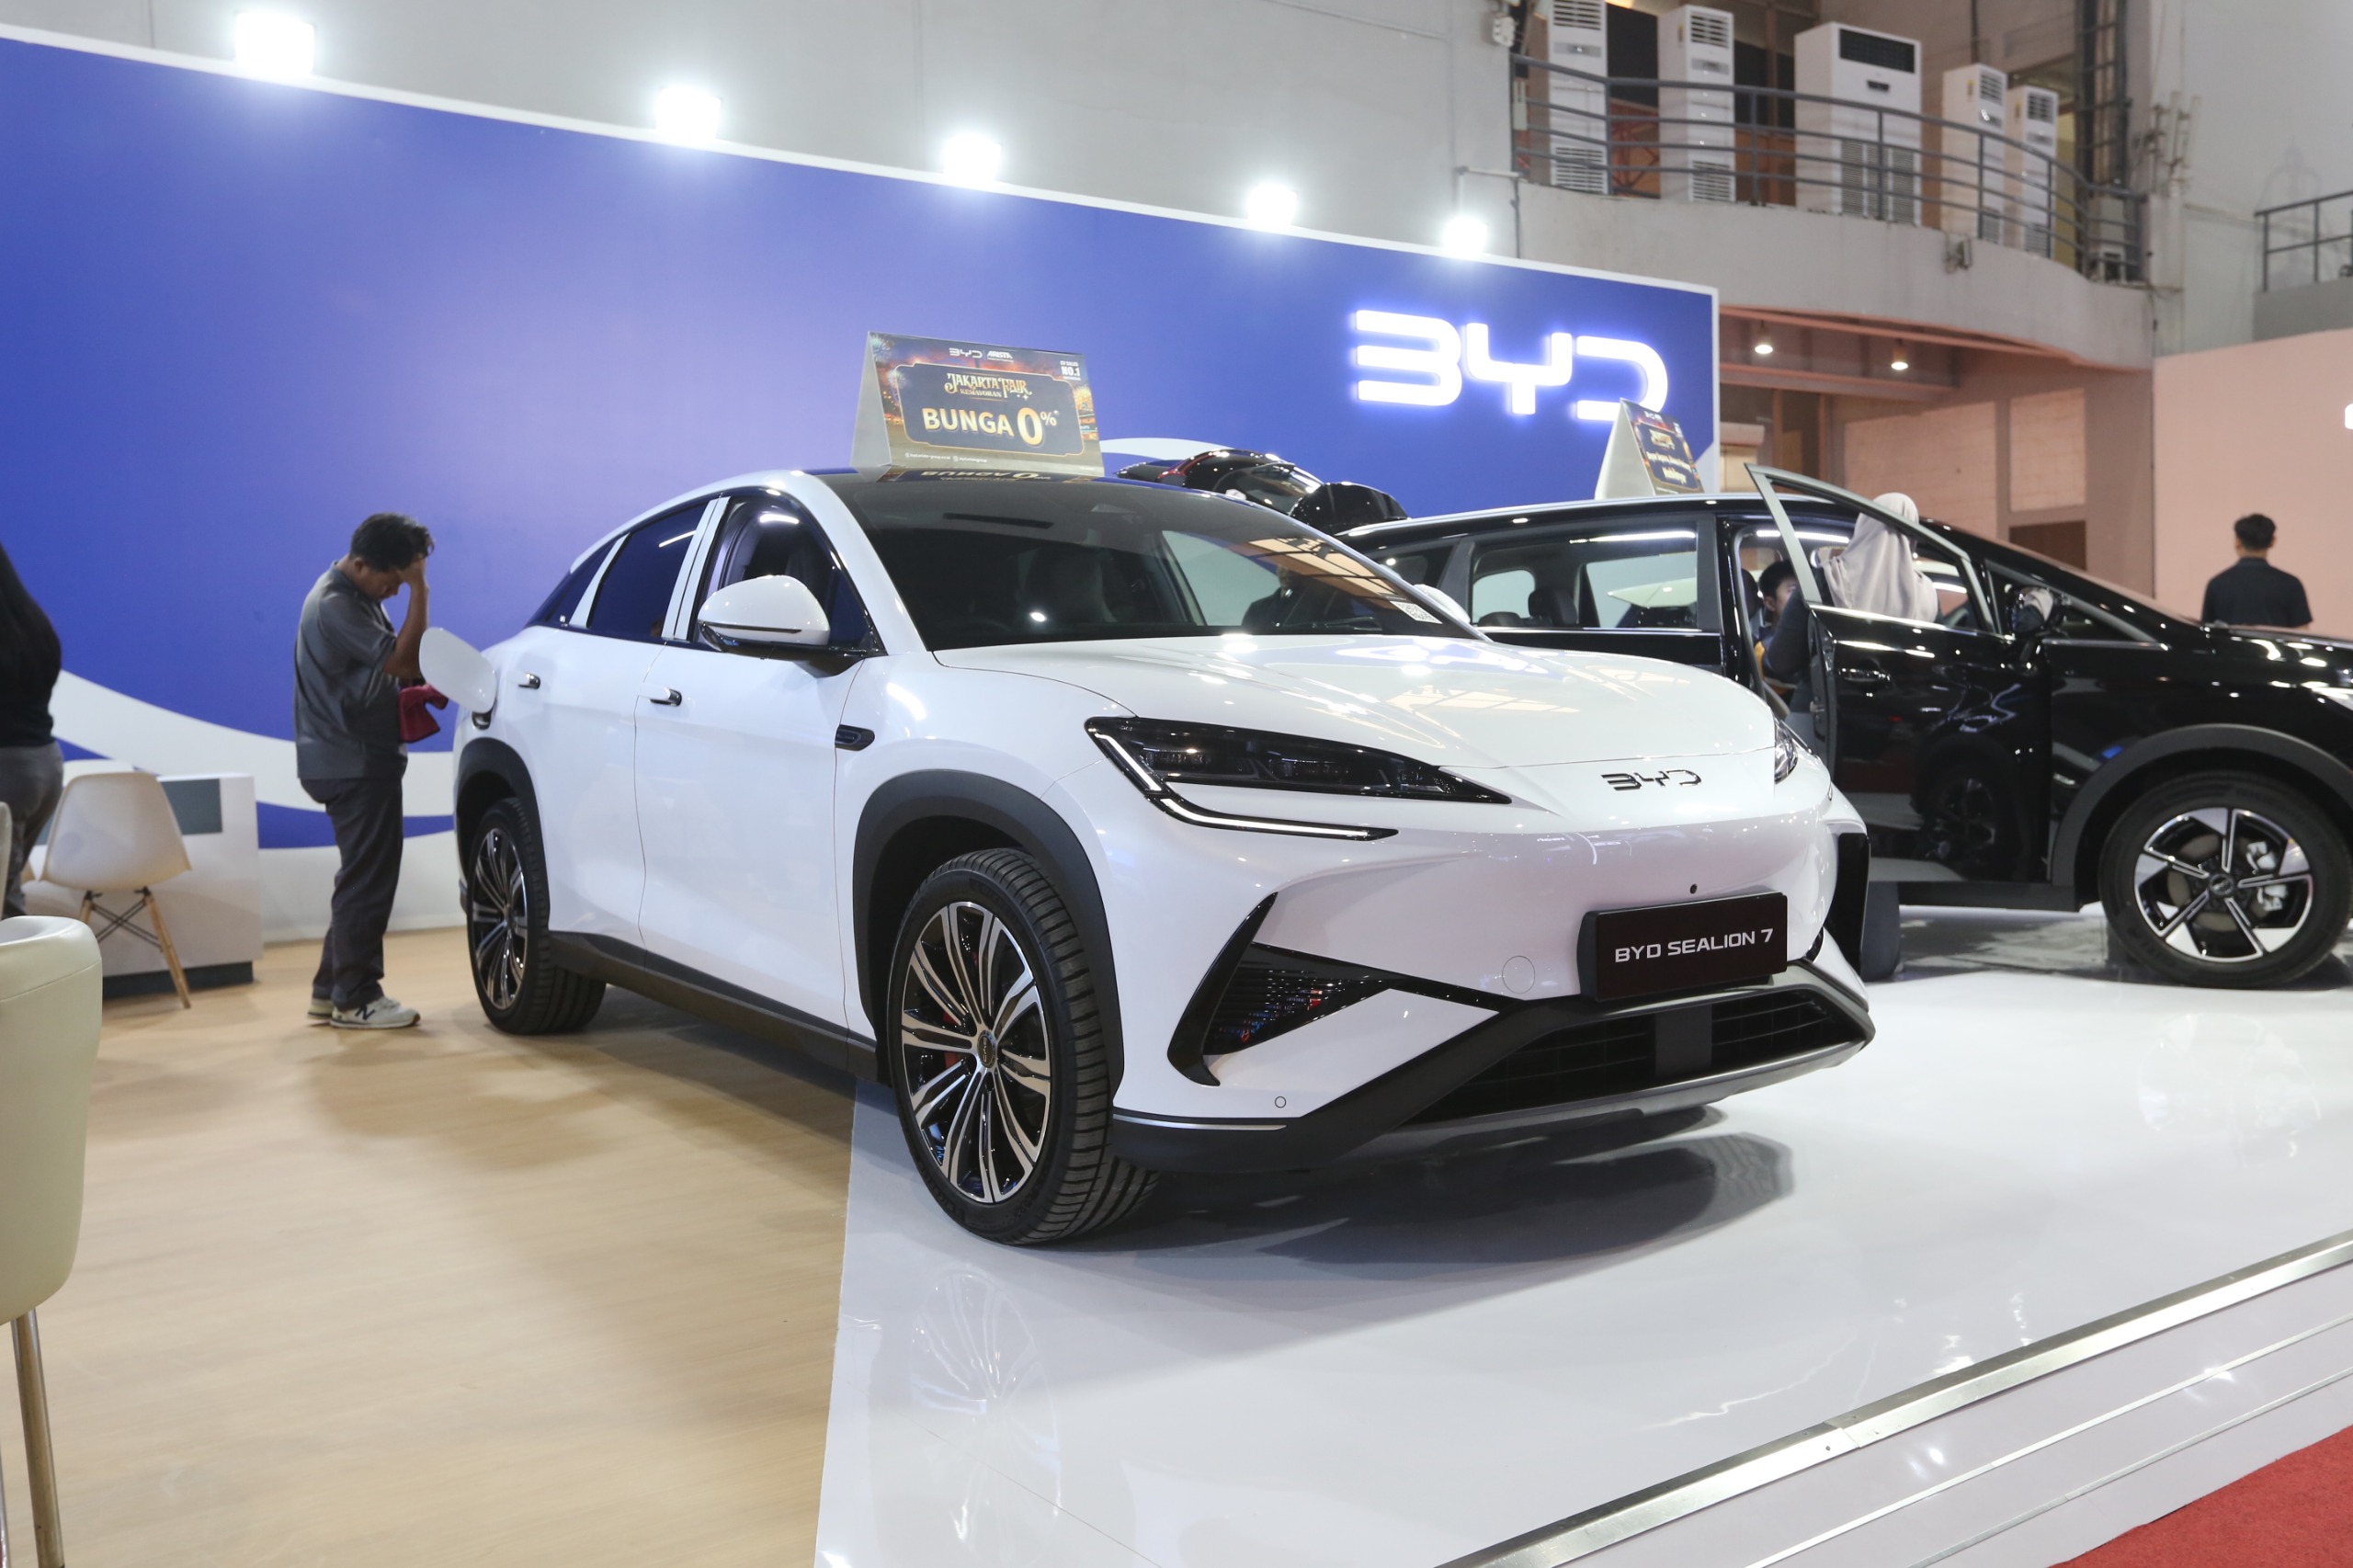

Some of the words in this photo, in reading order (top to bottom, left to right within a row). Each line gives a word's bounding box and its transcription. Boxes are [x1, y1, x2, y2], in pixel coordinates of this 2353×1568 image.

[949, 347, 983, 359] BYD
[1355, 310, 1668, 421] BYD
[1061, 366, 1081, 377] NO.1
[944, 372, 1000, 394] JAKARTA
[997, 377, 1032, 398] FAIR
[922, 407, 1014, 438] BUNGA
[1600, 769, 1702, 791] BYD
[1615, 943, 1661, 963] BYD
[1667, 930, 1756, 956] SEALION
[1760, 928, 1774, 943] 7
